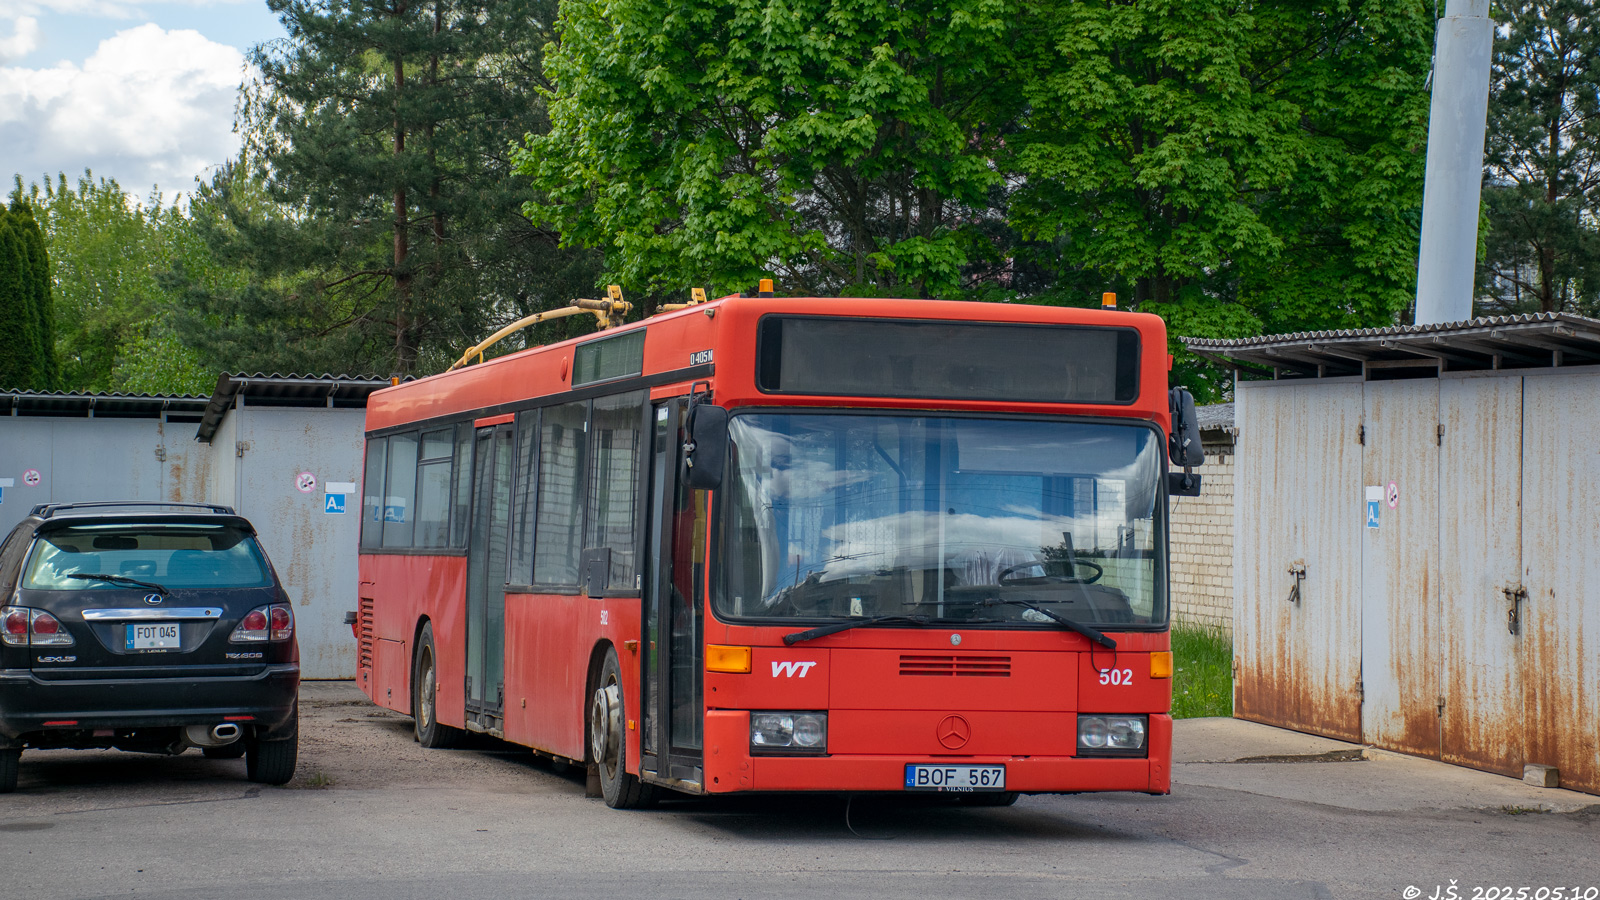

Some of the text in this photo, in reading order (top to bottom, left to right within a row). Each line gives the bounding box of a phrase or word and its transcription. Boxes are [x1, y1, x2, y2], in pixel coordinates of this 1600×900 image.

[600, 610, 608, 625] 502
[137, 626, 176, 639] FOT 045
[37, 655, 77, 663] LEXUS
[771, 661, 817, 678] VVT
[1099, 668, 1133, 686] 502
[917, 768, 1002, 786] BOF 567
